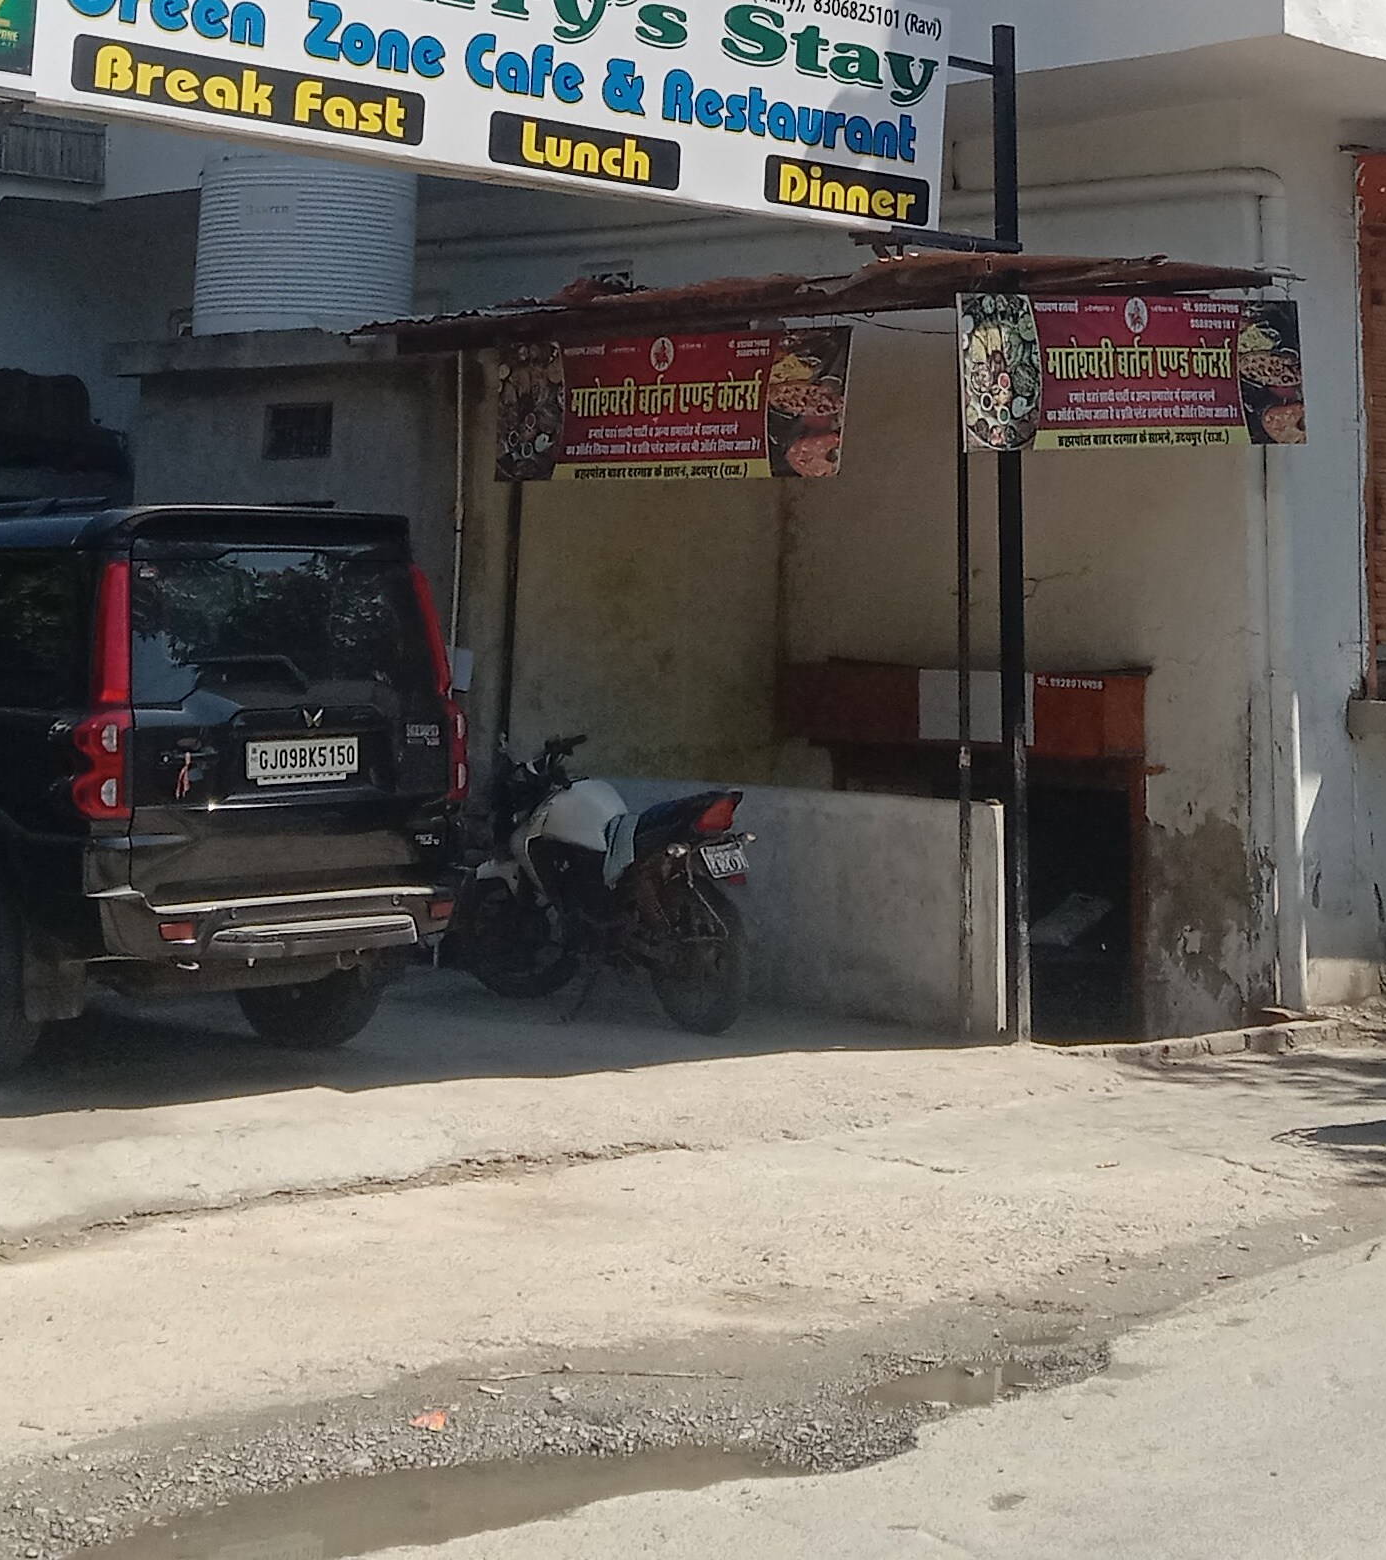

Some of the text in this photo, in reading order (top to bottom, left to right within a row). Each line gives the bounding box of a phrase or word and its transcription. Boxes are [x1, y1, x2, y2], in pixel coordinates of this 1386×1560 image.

[720, 3, 939, 106] Stay
[904, 12, 943, 41] (Ravi)
[93, 45, 406, 139] Break Fast
[303, 0, 445, 80] Zone
[465, 33, 585, 104] Cafe
[601, 59, 646, 117] &
[663, 69, 917, 164] Restaurant
[521, 121, 651, 182] Lunch
[778, 162, 916, 221] Dinner
[1046, 336, 1115, 380] मातेश्वरी
[1115, 335, 1154, 379] बर्तन
[1155, 345, 1190, 378] एण्ड
[638, 374, 676, 415] बर्तन
[679, 382, 715, 414] एण्ड
[259, 745, 355, 770] GJ09BK5150
